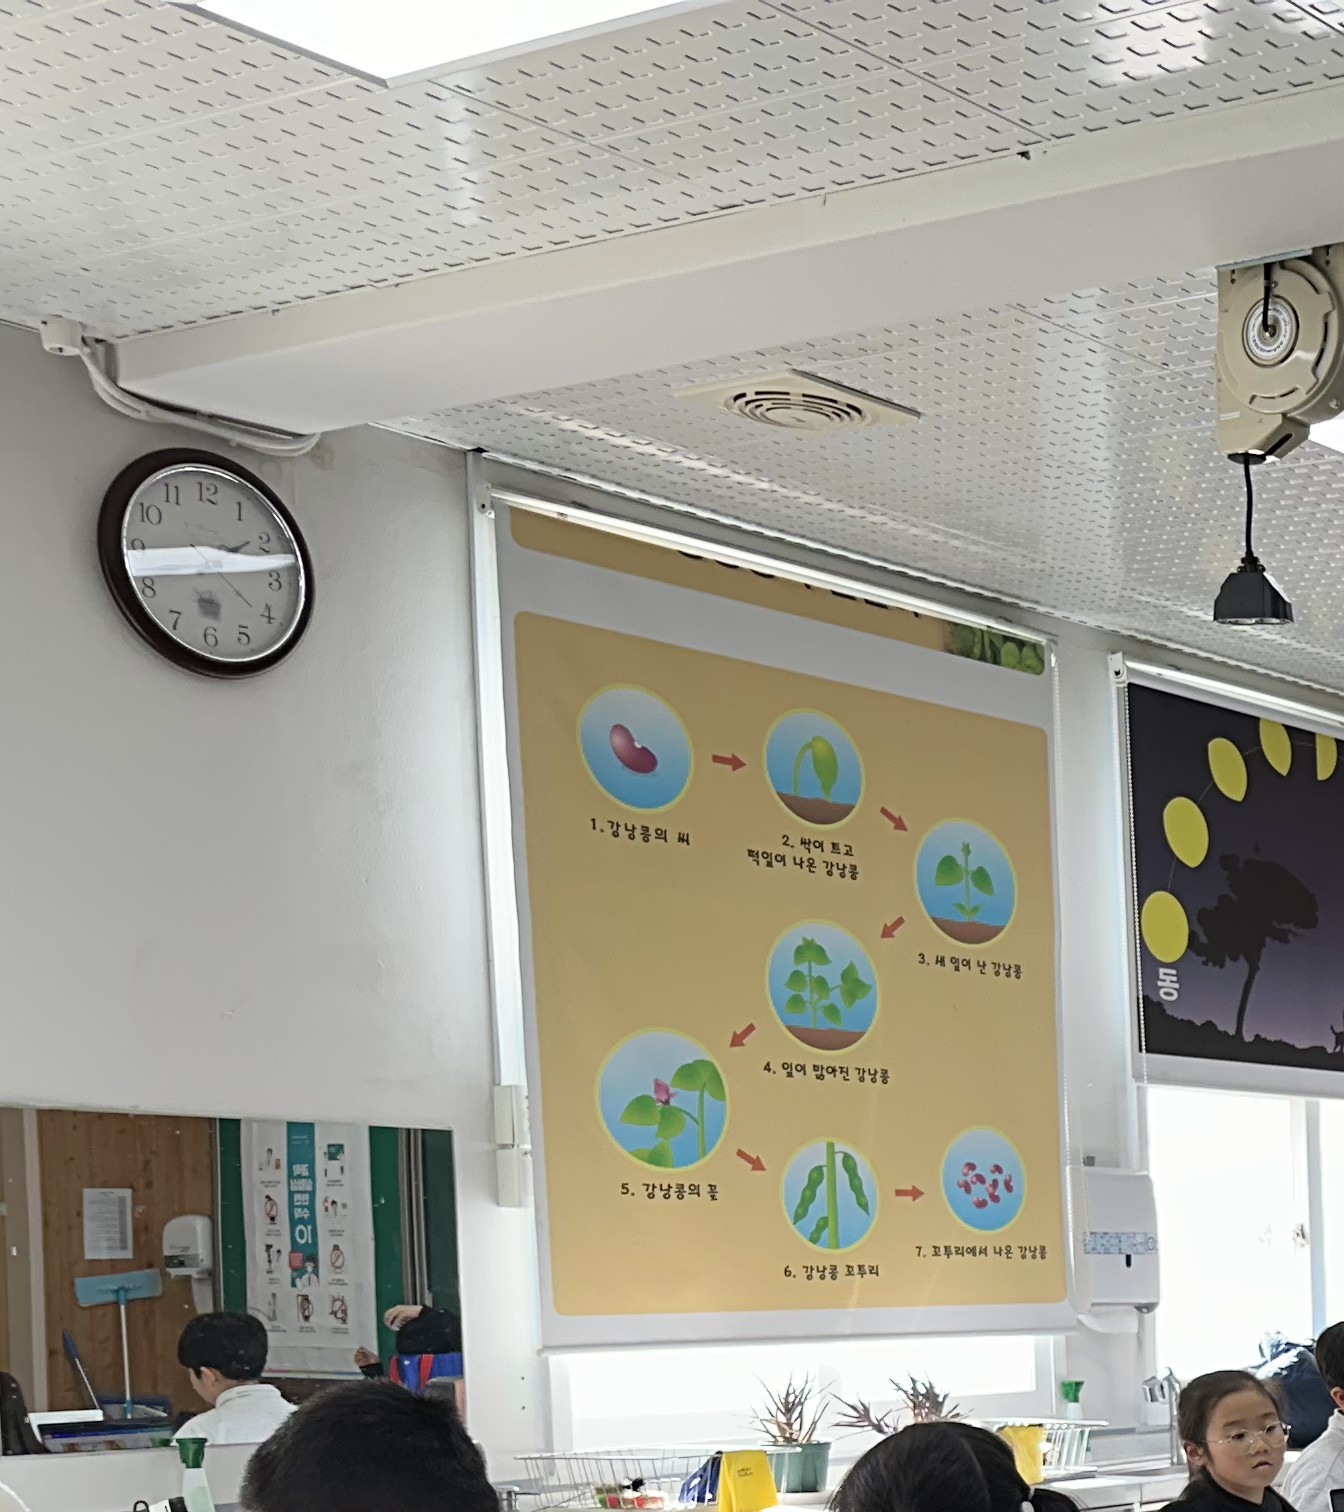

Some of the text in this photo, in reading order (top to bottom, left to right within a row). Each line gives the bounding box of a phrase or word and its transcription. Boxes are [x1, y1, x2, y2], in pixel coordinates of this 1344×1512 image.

[164, 483, 181, 506] 11
[197, 481, 219, 506] 12
[139, 502, 162, 526] 10
[235, 501, 243, 522] 1
[257, 531, 271, 553] 2
[141, 576, 156, 599] 8
[267, 570, 282, 591] 3
[168, 608, 182, 630] 7
[259, 602, 276, 625] 4
[203, 625, 219, 648] 6
[236, 624, 251, 649] 5
[677, 831, 691, 846] 씨
[782, 834, 854, 857] 2. 싹이 트고
[792, 856, 818, 874] 나온
[822, 860, 860, 881] 강낭콩
[918, 952, 931, 967] 3.
[949, 956, 972, 973] 잎이
[976, 959, 988, 975] 난
[990, 961, 1023, 980] 강낭콩
[1156, 967, 1180, 1002] 동
[763, 1061, 890, 1085] 4. 잎이 많아진 강낭콩
[620, 1182, 719, 1202] 5. 강낭콩의 꽃
[915, 1244, 1048, 1260] 7. 꼬투리에서 나온 강낭콩
[783, 1264, 880, 1281] 6. 강낭콩 꼬투리
